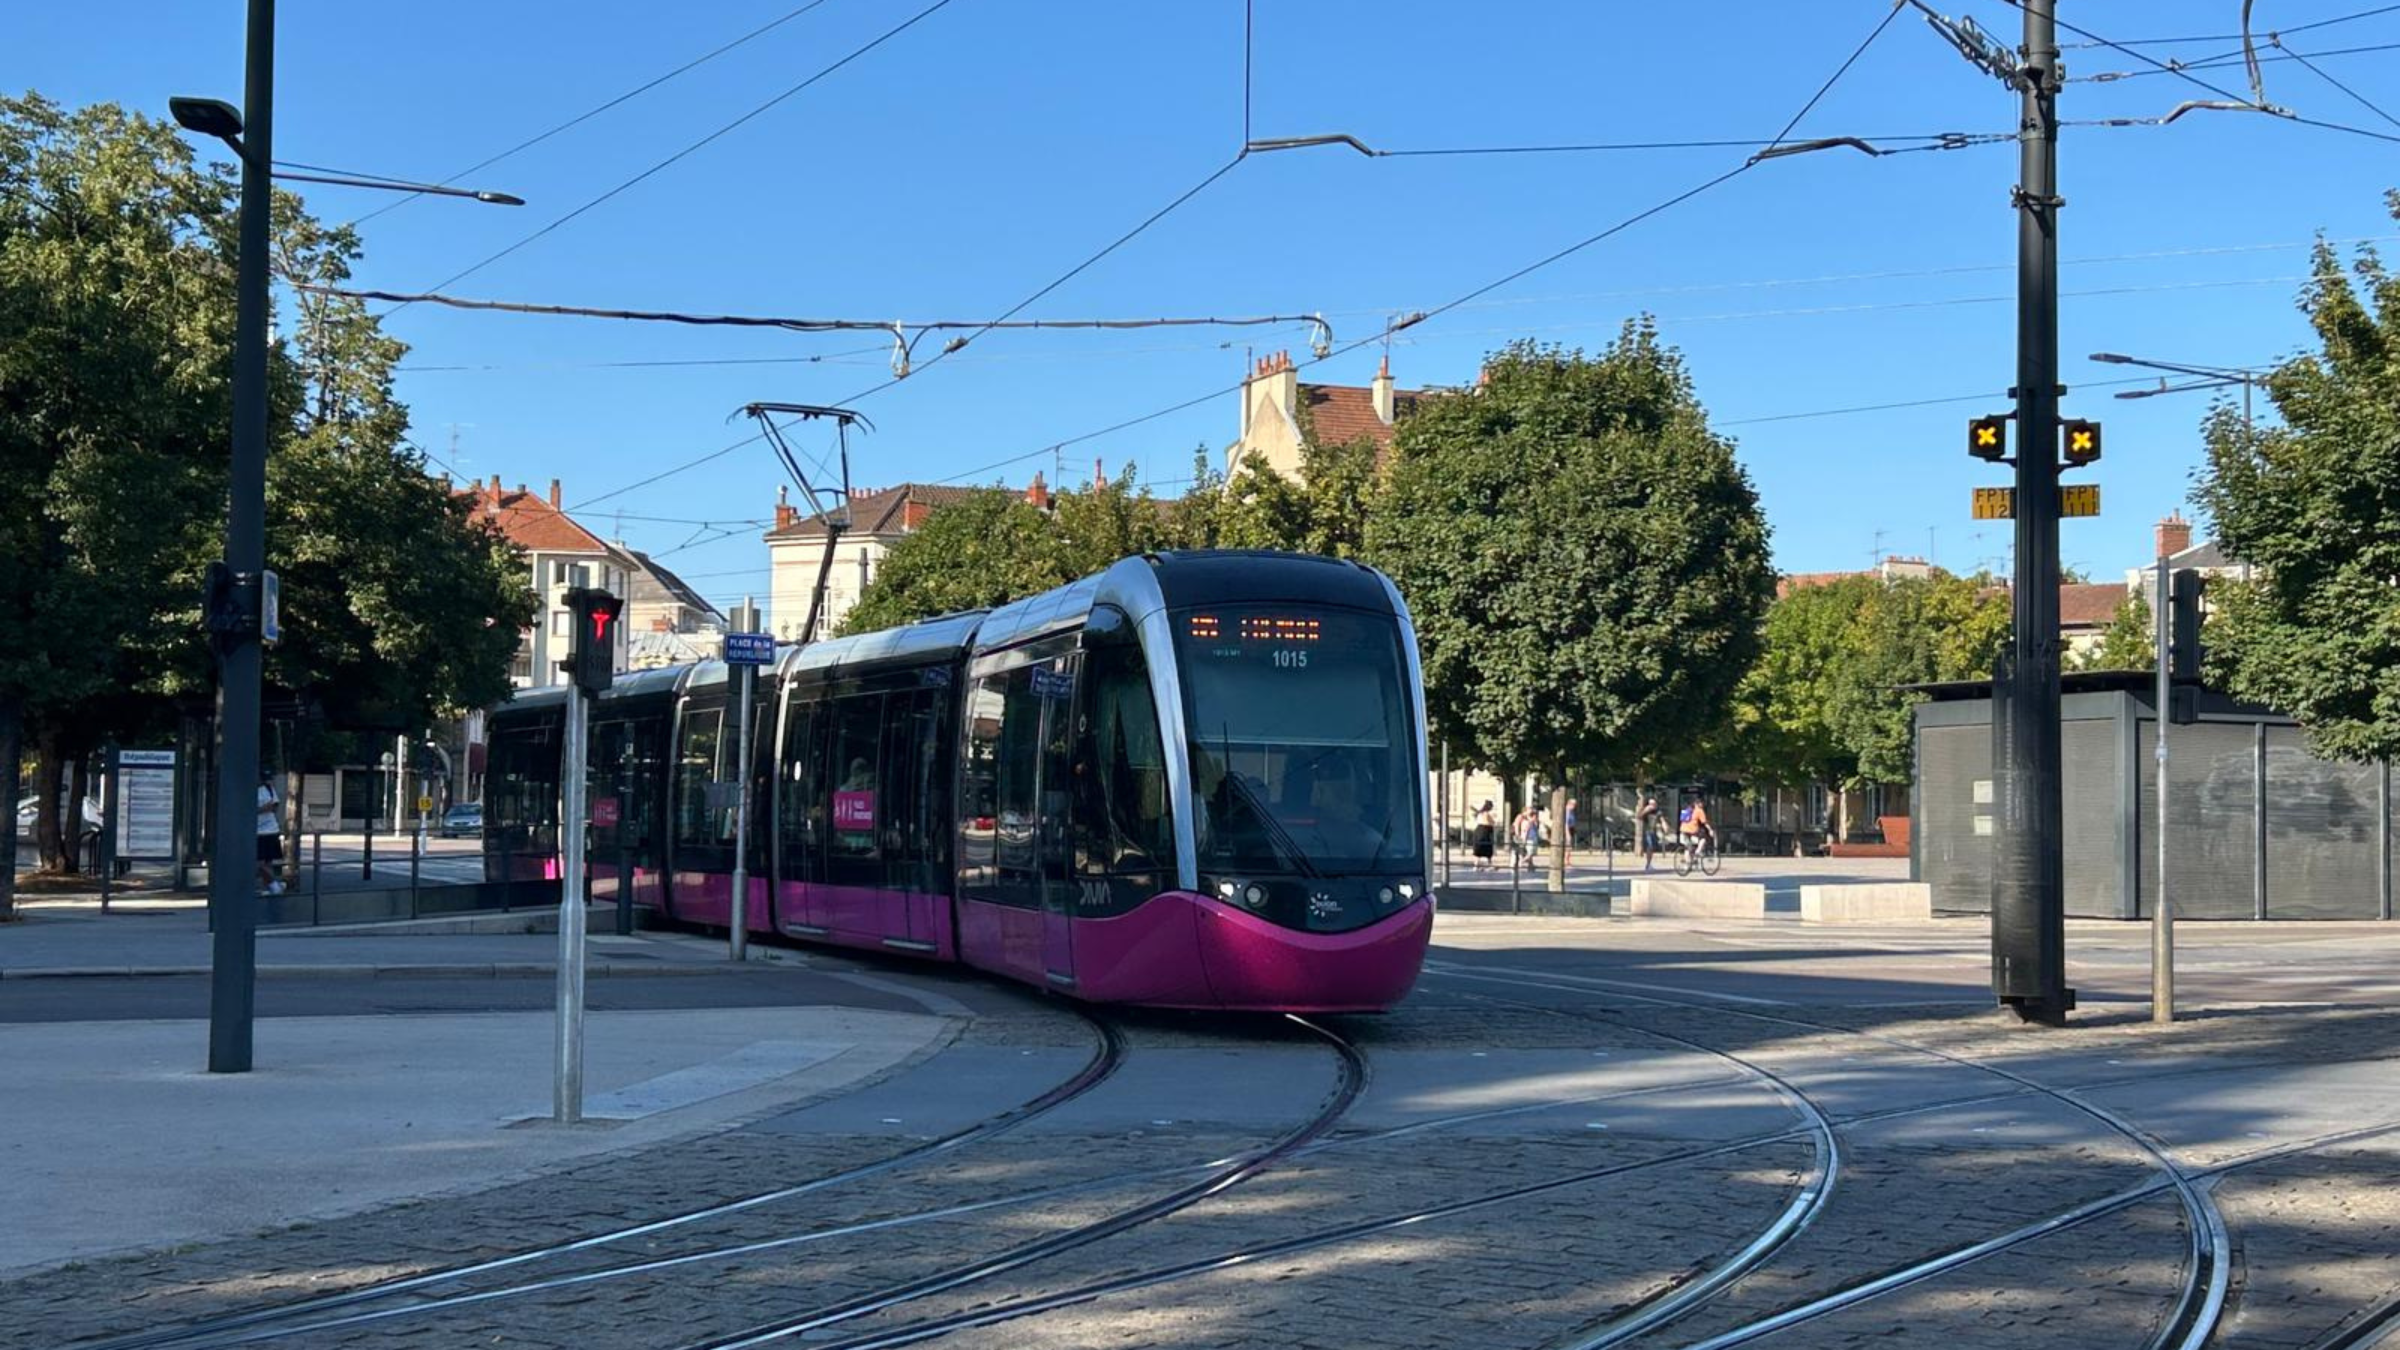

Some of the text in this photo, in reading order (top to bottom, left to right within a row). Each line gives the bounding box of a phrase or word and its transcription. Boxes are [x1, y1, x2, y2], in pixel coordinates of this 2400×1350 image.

[1978, 504, 2008, 518] 112
[730, 638, 751, 648] PLACE
[1273, 650, 1308, 667] 1015
